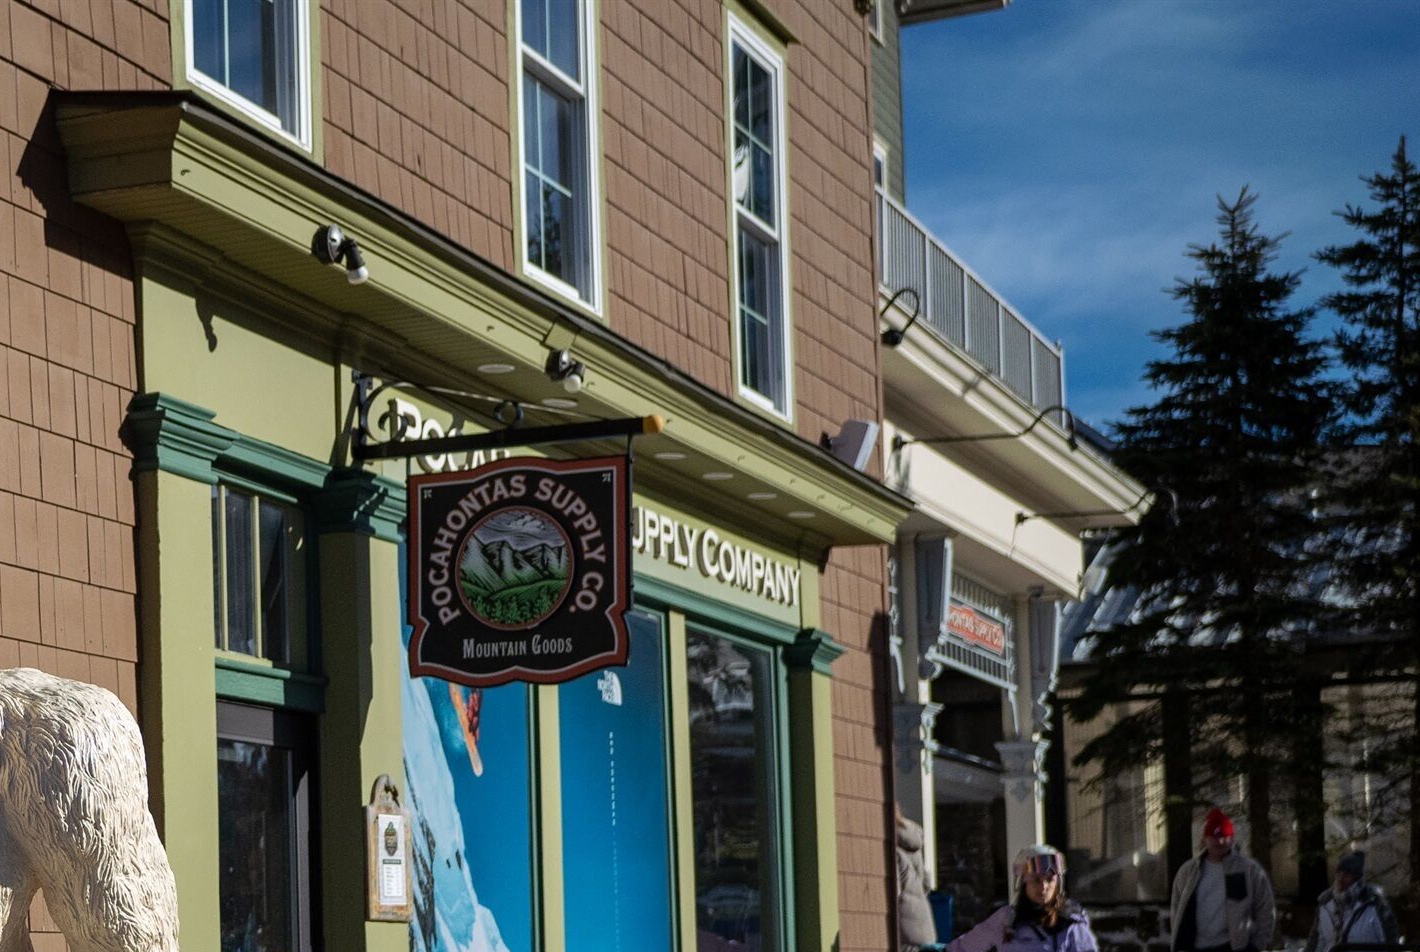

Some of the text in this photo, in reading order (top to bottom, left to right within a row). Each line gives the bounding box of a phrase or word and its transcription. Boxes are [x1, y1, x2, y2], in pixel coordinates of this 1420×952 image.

[428, 474, 607, 627] POCAHONTAS SUPPLY CO.
[702, 528, 800, 607] COMPANY
